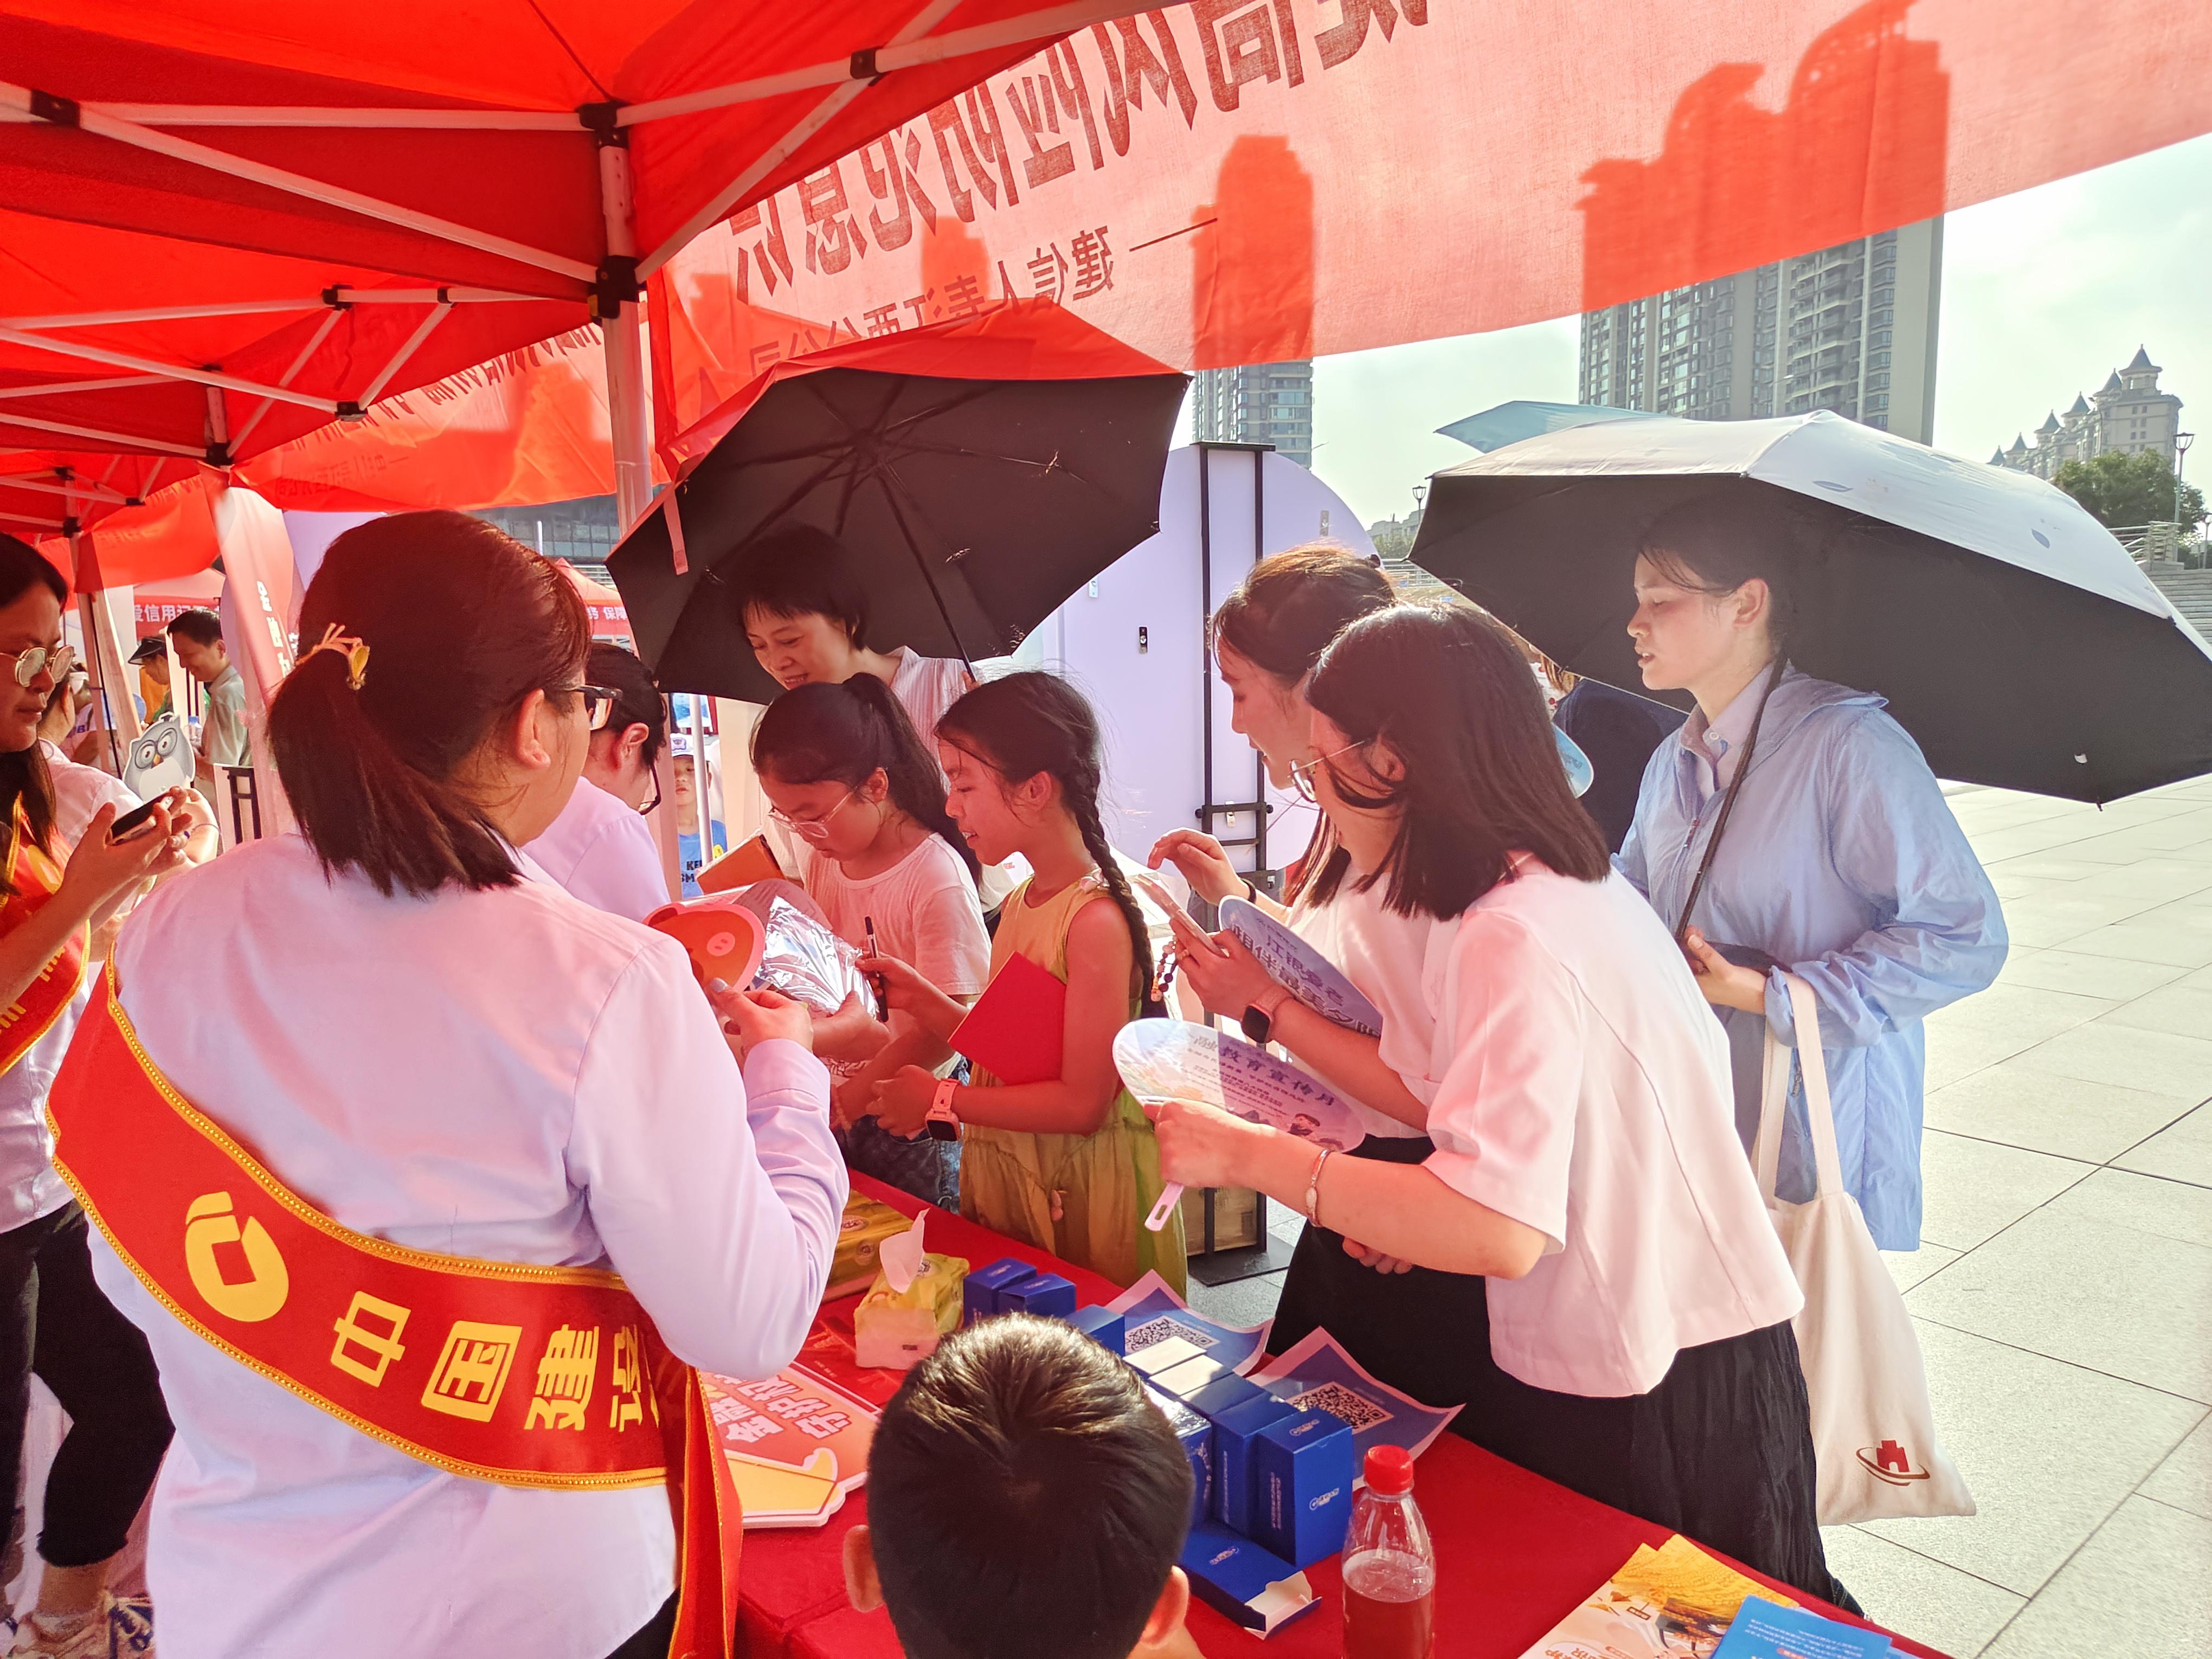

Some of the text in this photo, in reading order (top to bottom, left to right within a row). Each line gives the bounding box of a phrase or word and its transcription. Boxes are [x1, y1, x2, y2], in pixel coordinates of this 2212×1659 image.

[1187, 1032, 1335, 1106] 融教育宣传月
[330, 1291, 660, 1432] 中国建设
[714, 1374, 852, 1439] 守护权
